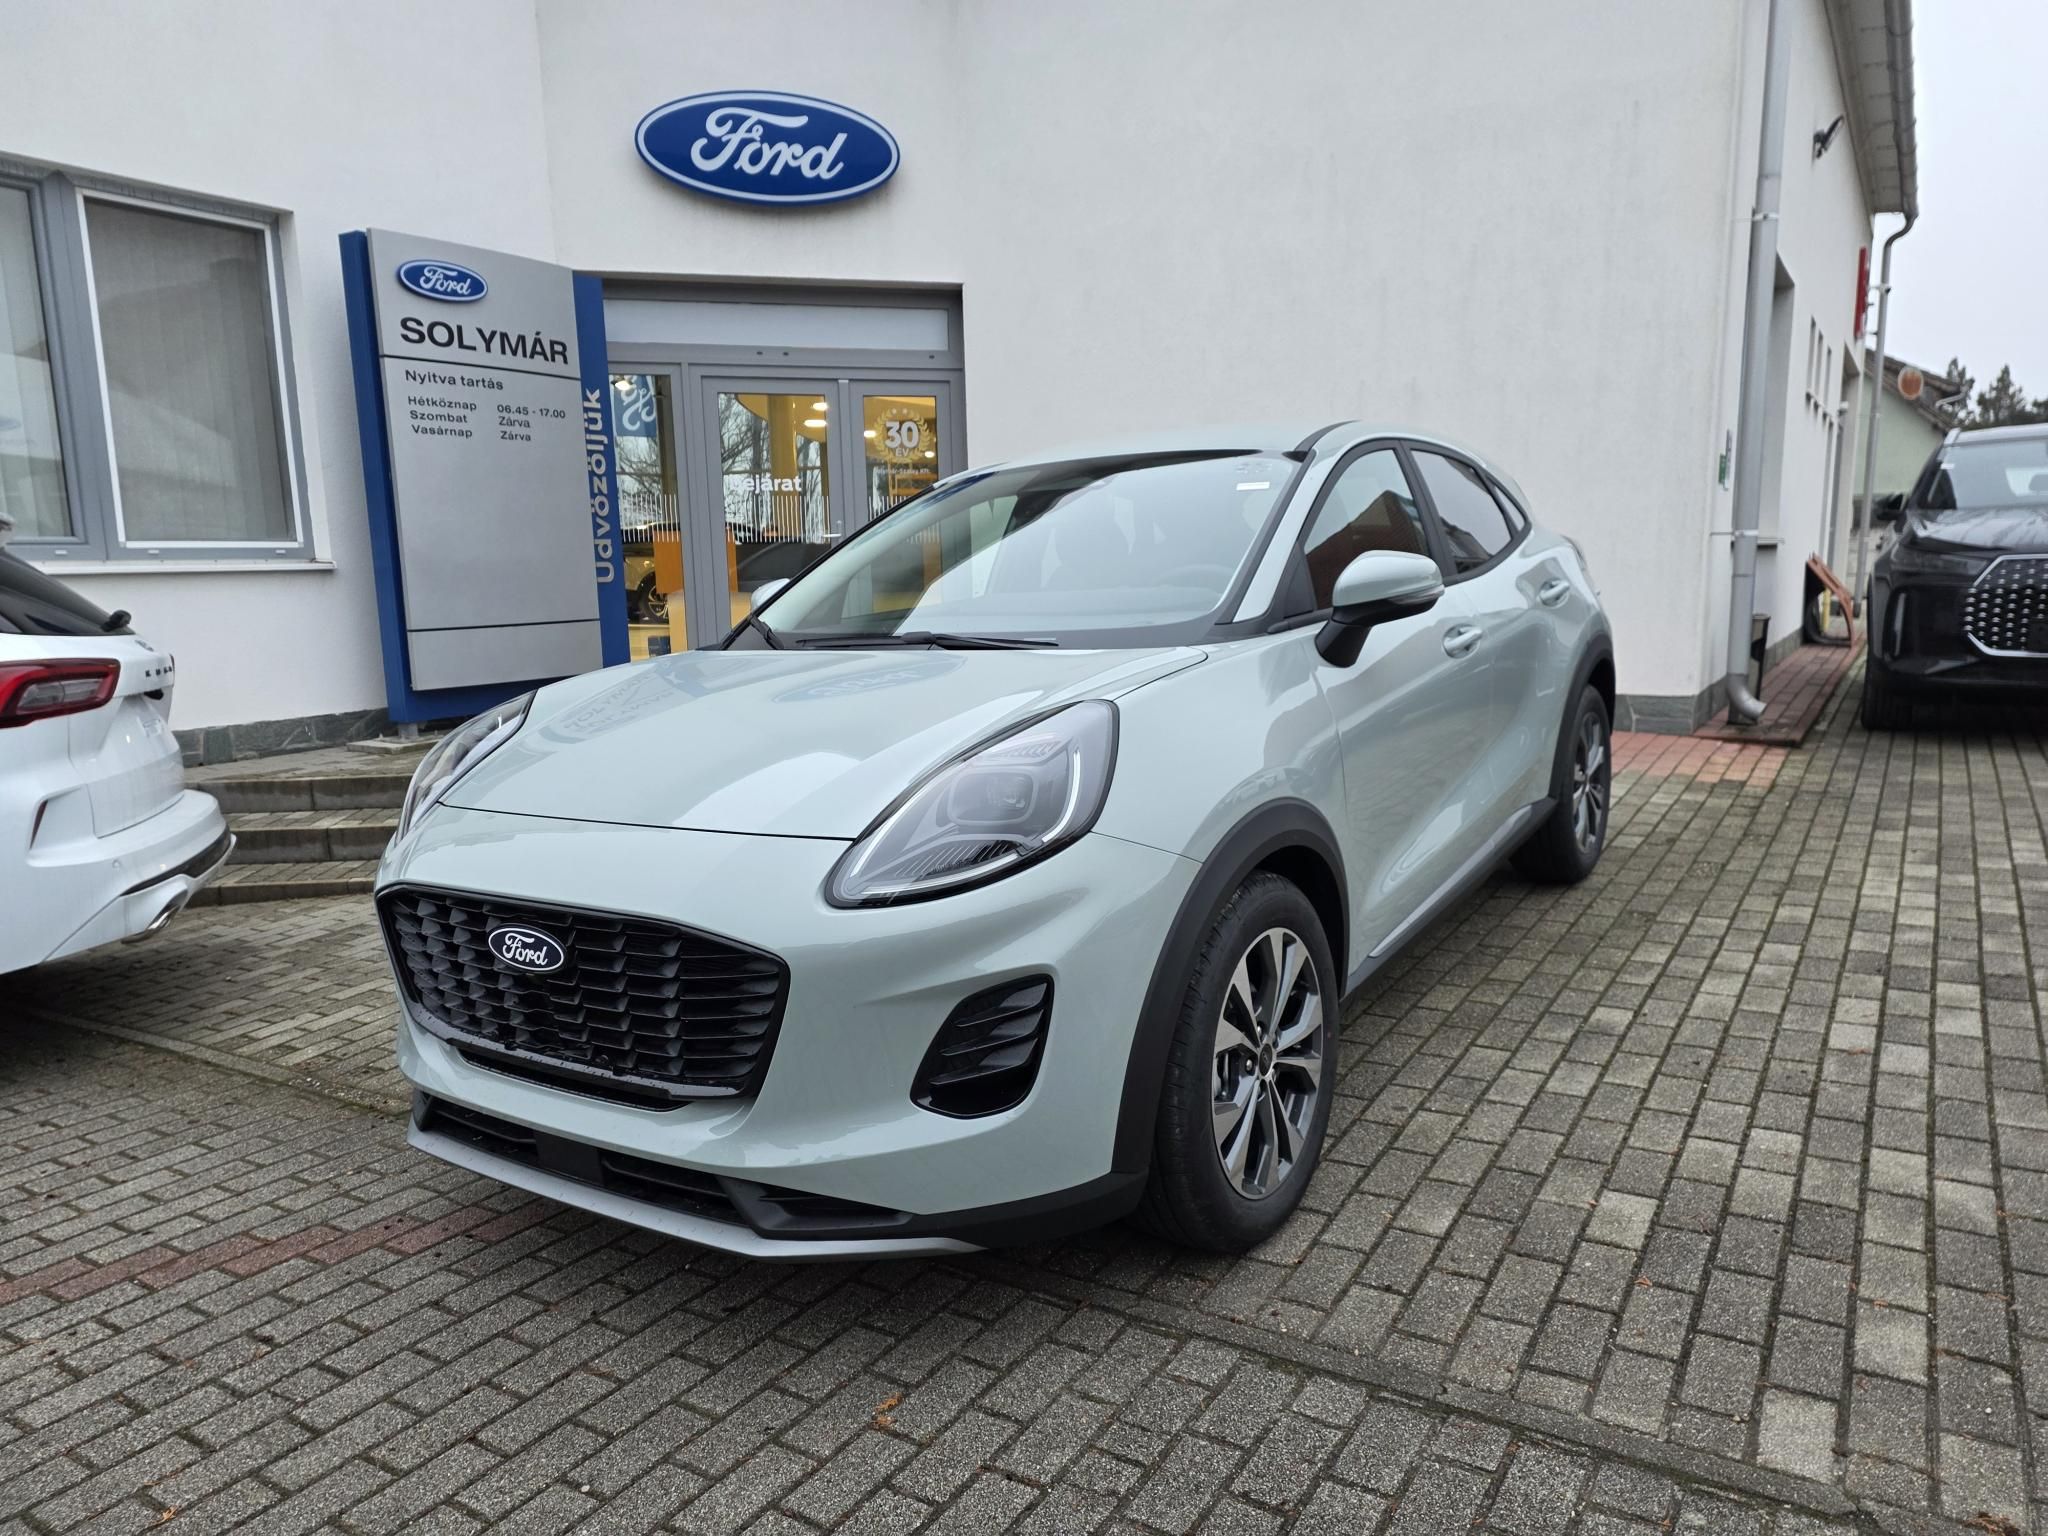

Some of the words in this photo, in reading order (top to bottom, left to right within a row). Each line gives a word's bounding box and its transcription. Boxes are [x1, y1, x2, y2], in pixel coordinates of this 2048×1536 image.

[690, 106, 848, 180] Ford
[419, 265, 471, 296] Ford
[400, 316, 569, 364] SOLYMÁR
[405, 369, 456, 385] Nyitva
[460, 375, 504, 390] tartás
[408, 395, 477, 412] Hétköznap
[497, 404, 529, 416] 06.45
[539, 408, 566, 419] 17.00
[410, 409, 468, 423] Szombat
[498, 415, 530, 428] Zárva
[411, 424, 473, 439] Vasárnap
[500, 430, 532, 441] Zárva
[885, 420, 919, 448] 30
[729, 472, 802, 494] ejárat
[502, 932, 548, 965] Ford
